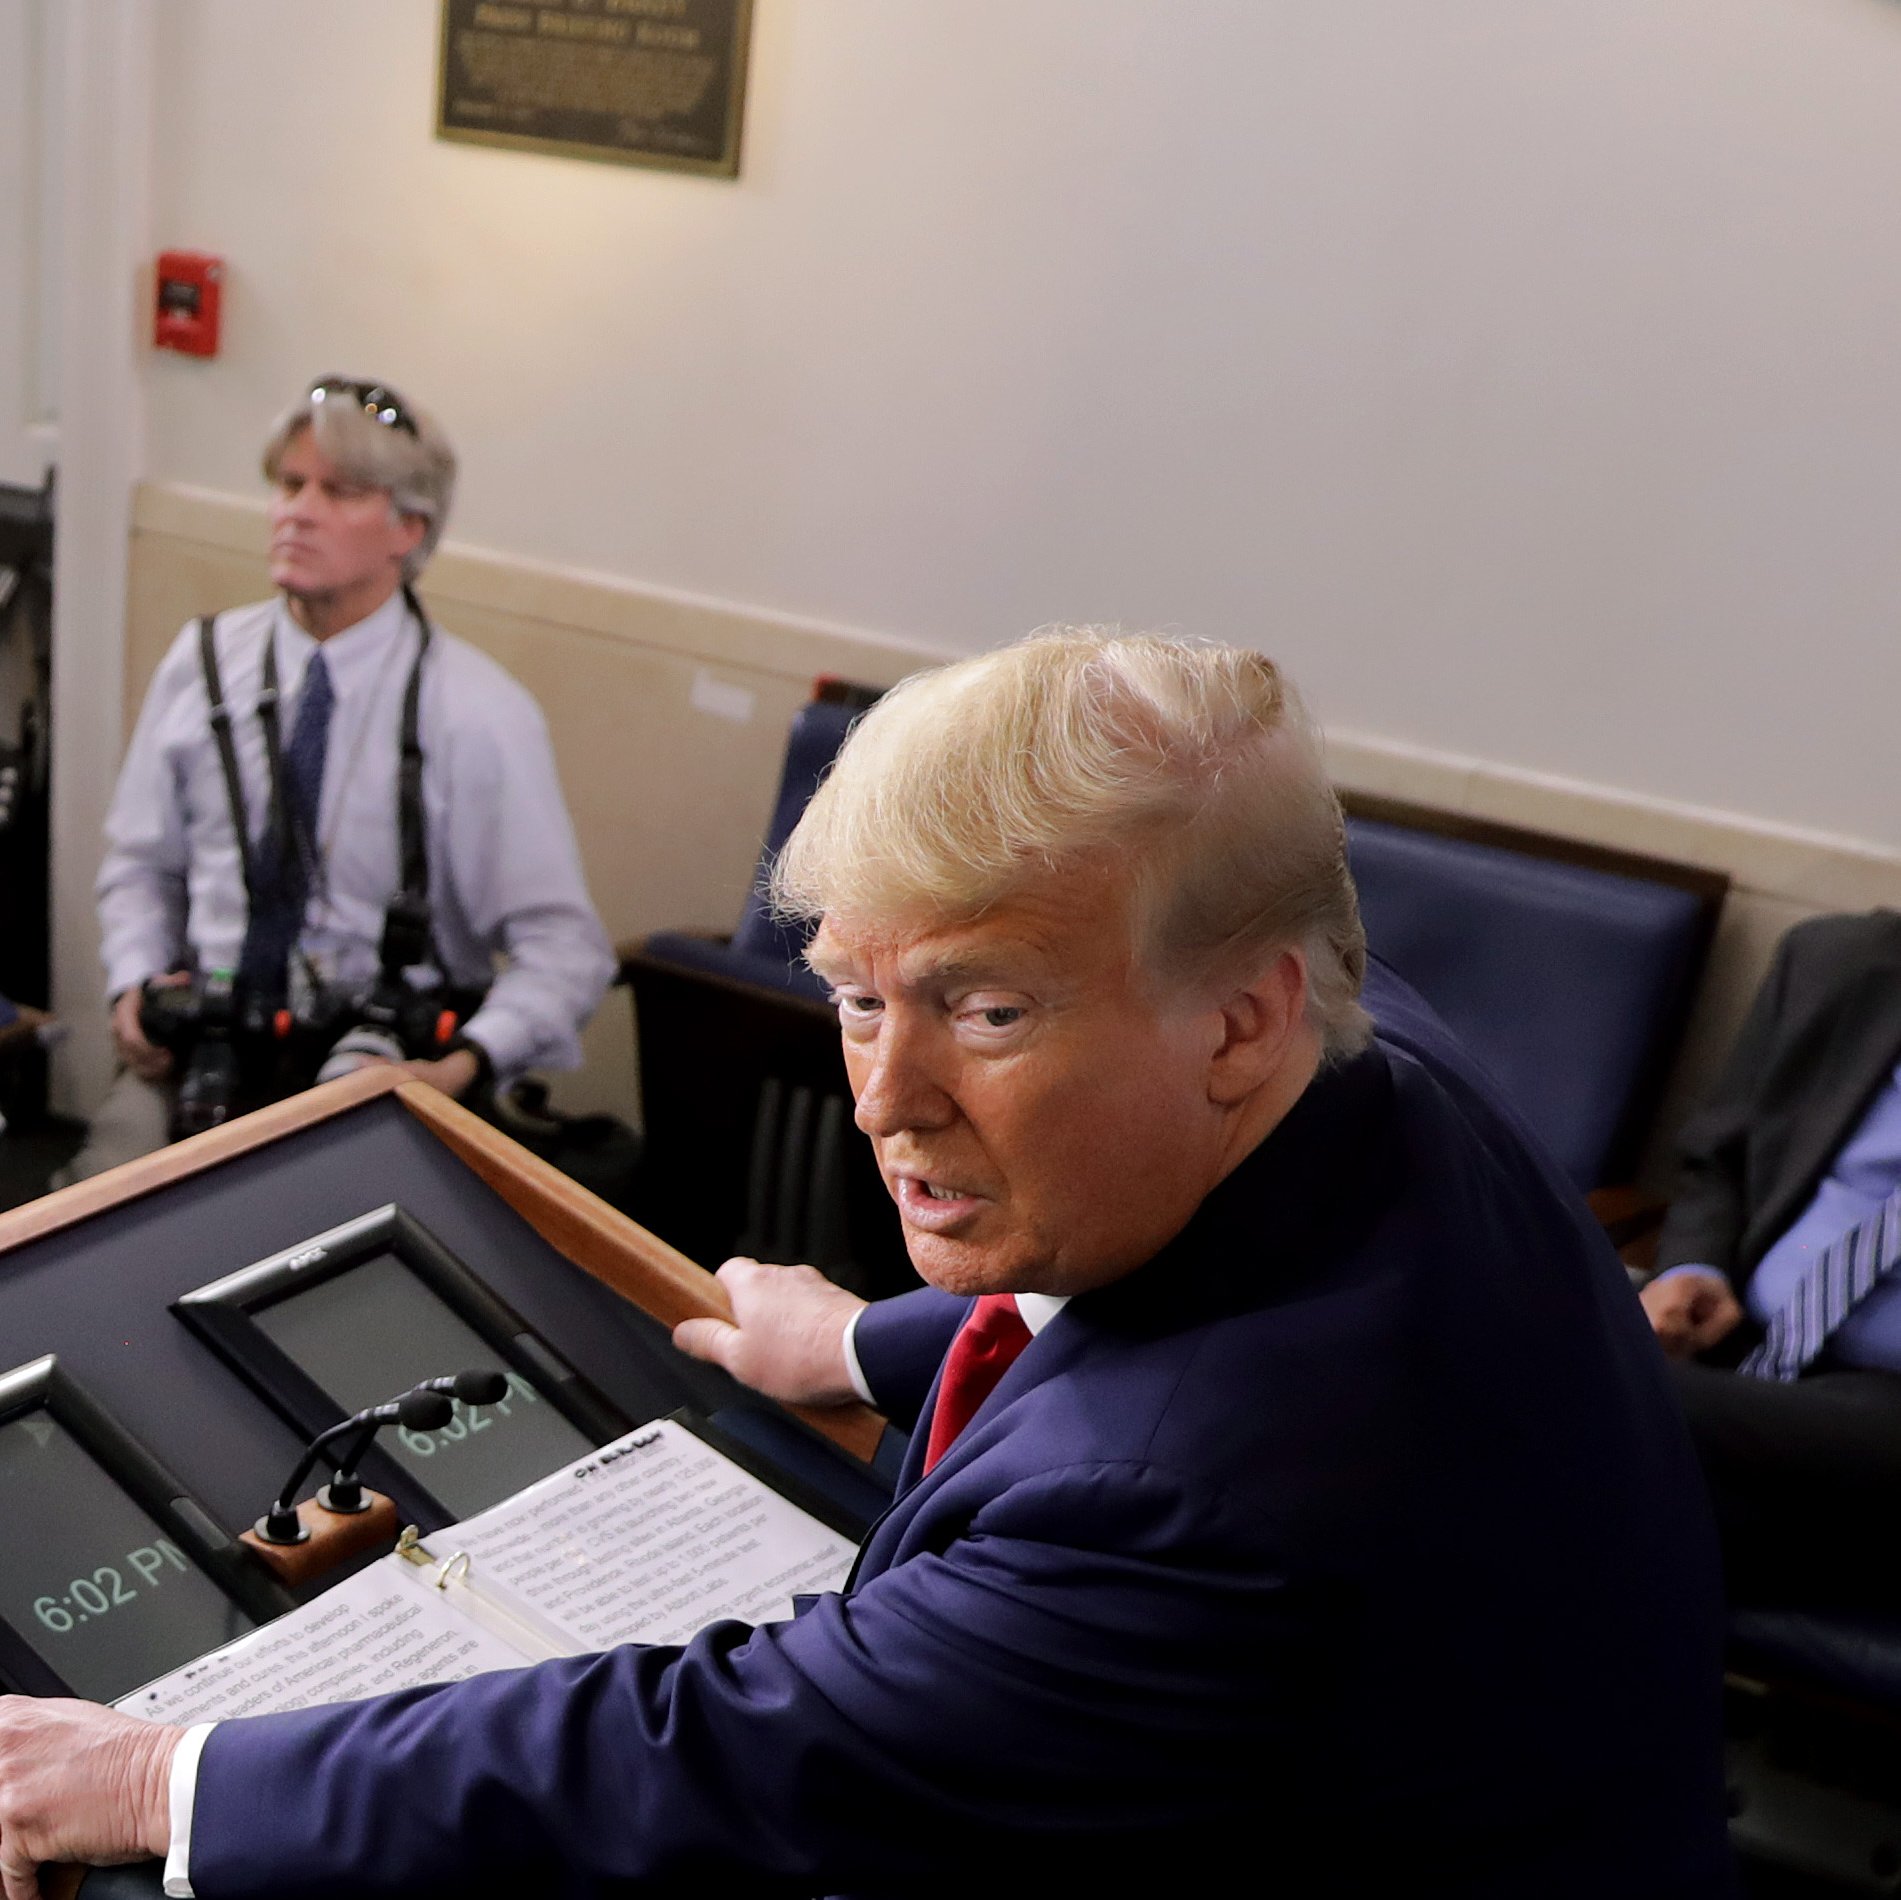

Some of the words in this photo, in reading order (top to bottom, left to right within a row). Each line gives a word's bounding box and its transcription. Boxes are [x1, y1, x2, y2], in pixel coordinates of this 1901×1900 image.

[527, 1484, 582, 1518] performed
[540, 1513, 570, 1531] more
[567, 1500, 593, 1517] than
[593, 1489, 616, 1504] any
[614, 1475, 642, 1492] other
[641, 1457, 682, 1479] country
[575, 1524, 588, 1534] is
[586, 1502, 632, 1530] growing
[626, 1496, 645, 1509] by
[642, 1480, 677, 1499] nearly
[509, 1565, 547, 1587] people
[544, 1556, 564, 1571] per
[623, 1500, 677, 1529] launching
[672, 1490, 696, 1506] two
[693, 1479, 717, 1491] new
[592, 1544, 633, 1566] testing
[654, 1524, 668, 1535] in
[594, 1591, 620, 1607] able
[616, 1584, 633, 1595] to
[664, 1559, 681, 1569] to
[709, 1522, 752, 1548] patients
[749, 1512, 768, 1528] per
[542, 1595, 566, 1610] and
[623, 1545, 664, 1569] Rhode
[693, 1515, 725, 1534] Each
[34, 1567, 137, 1633] 6:02
[578, 1621, 602, 1634] day
[599, 1603, 633, 1625] using
[626, 1597, 649, 1611] the
[681, 1603, 734, 1632] speeding
[225, 1677, 252, 1697] and
[283, 1649, 309, 1664] this
[307, 1619, 363, 1653] afternoon
[367, 1594, 404, 1618] spoke
[370, 1628, 424, 1663] including
[596, 1616, 652, 1646] developed
[647, 1609, 668, 1621] by
[144, 1704, 165, 1718] As
[163, 1694, 184, 1707] we
[183, 1666, 234, 1697] continue
[233, 1656, 253, 1669] our
[254, 1637, 292, 1659] efforts
[287, 1631, 305, 1641] to
[303, 1603, 350, 1634] develop
[225, 1690, 273, 1721] leaders
[270, 1679, 286, 1694] of
[283, 1655, 339, 1686] American
[339, 1603, 423, 1660] pharmaceutical
[370, 1665, 395, 1685] and
[417, 1652, 459, 1681] agents
[456, 1639, 479, 1656] are
